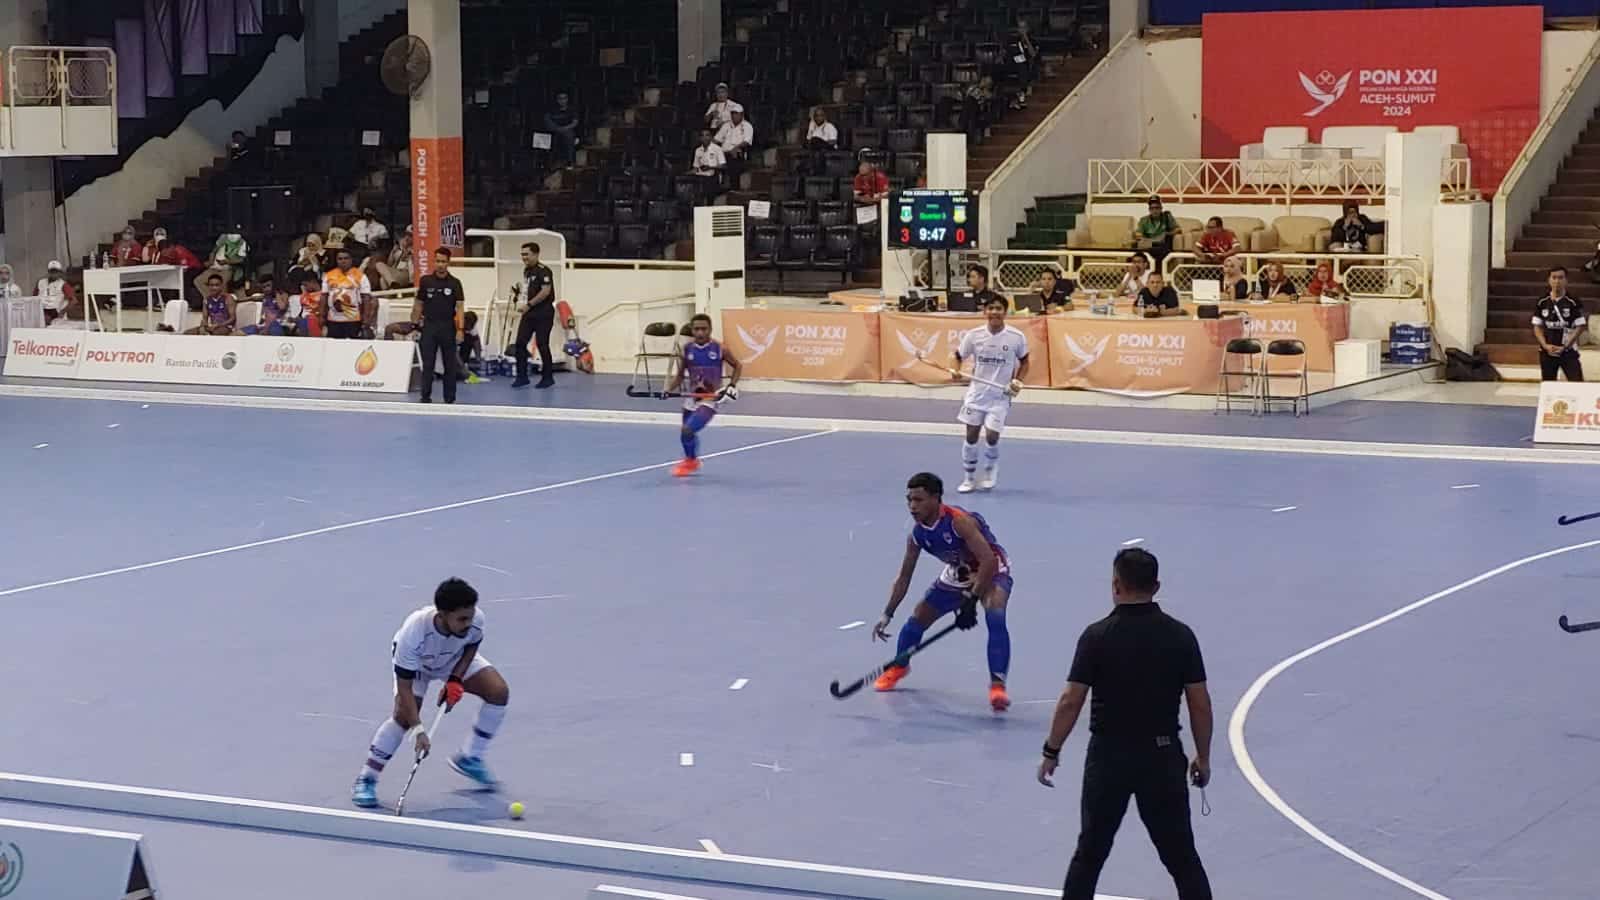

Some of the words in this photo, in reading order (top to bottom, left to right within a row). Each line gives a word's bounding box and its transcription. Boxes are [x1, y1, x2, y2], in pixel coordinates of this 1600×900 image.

[1360, 69, 1400, 85] PON
[1405, 69, 1437, 85] XXI
[1360, 93, 1436, 104] ACEH-SUMUT
[1383, 106, 1412, 116] 2024
[417, 149, 427, 176] PON
[417, 179, 428, 200] XXI
[418, 203, 428, 237] ACEH
[901, 227, 910, 243] 3
[919, 227, 946, 241] 9:47
[955, 227, 966, 243] 0
[785, 325, 818, 338] PON
[821, 326, 848, 338] XXI
[1271, 319, 1296, 332] XXI
[12, 339, 80, 358] Telkomsel
[1117, 334, 1153, 347] PON
[1156, 335, 1185, 349] XXI
[86, 350, 156, 364] POLYTRON
[192, 359, 219, 369] Pacific
[1118, 355, 1183, 367] ACEH-SUMUT
[264, 363, 304, 375] BAYAN
[1136, 367, 1162, 376] 2024
